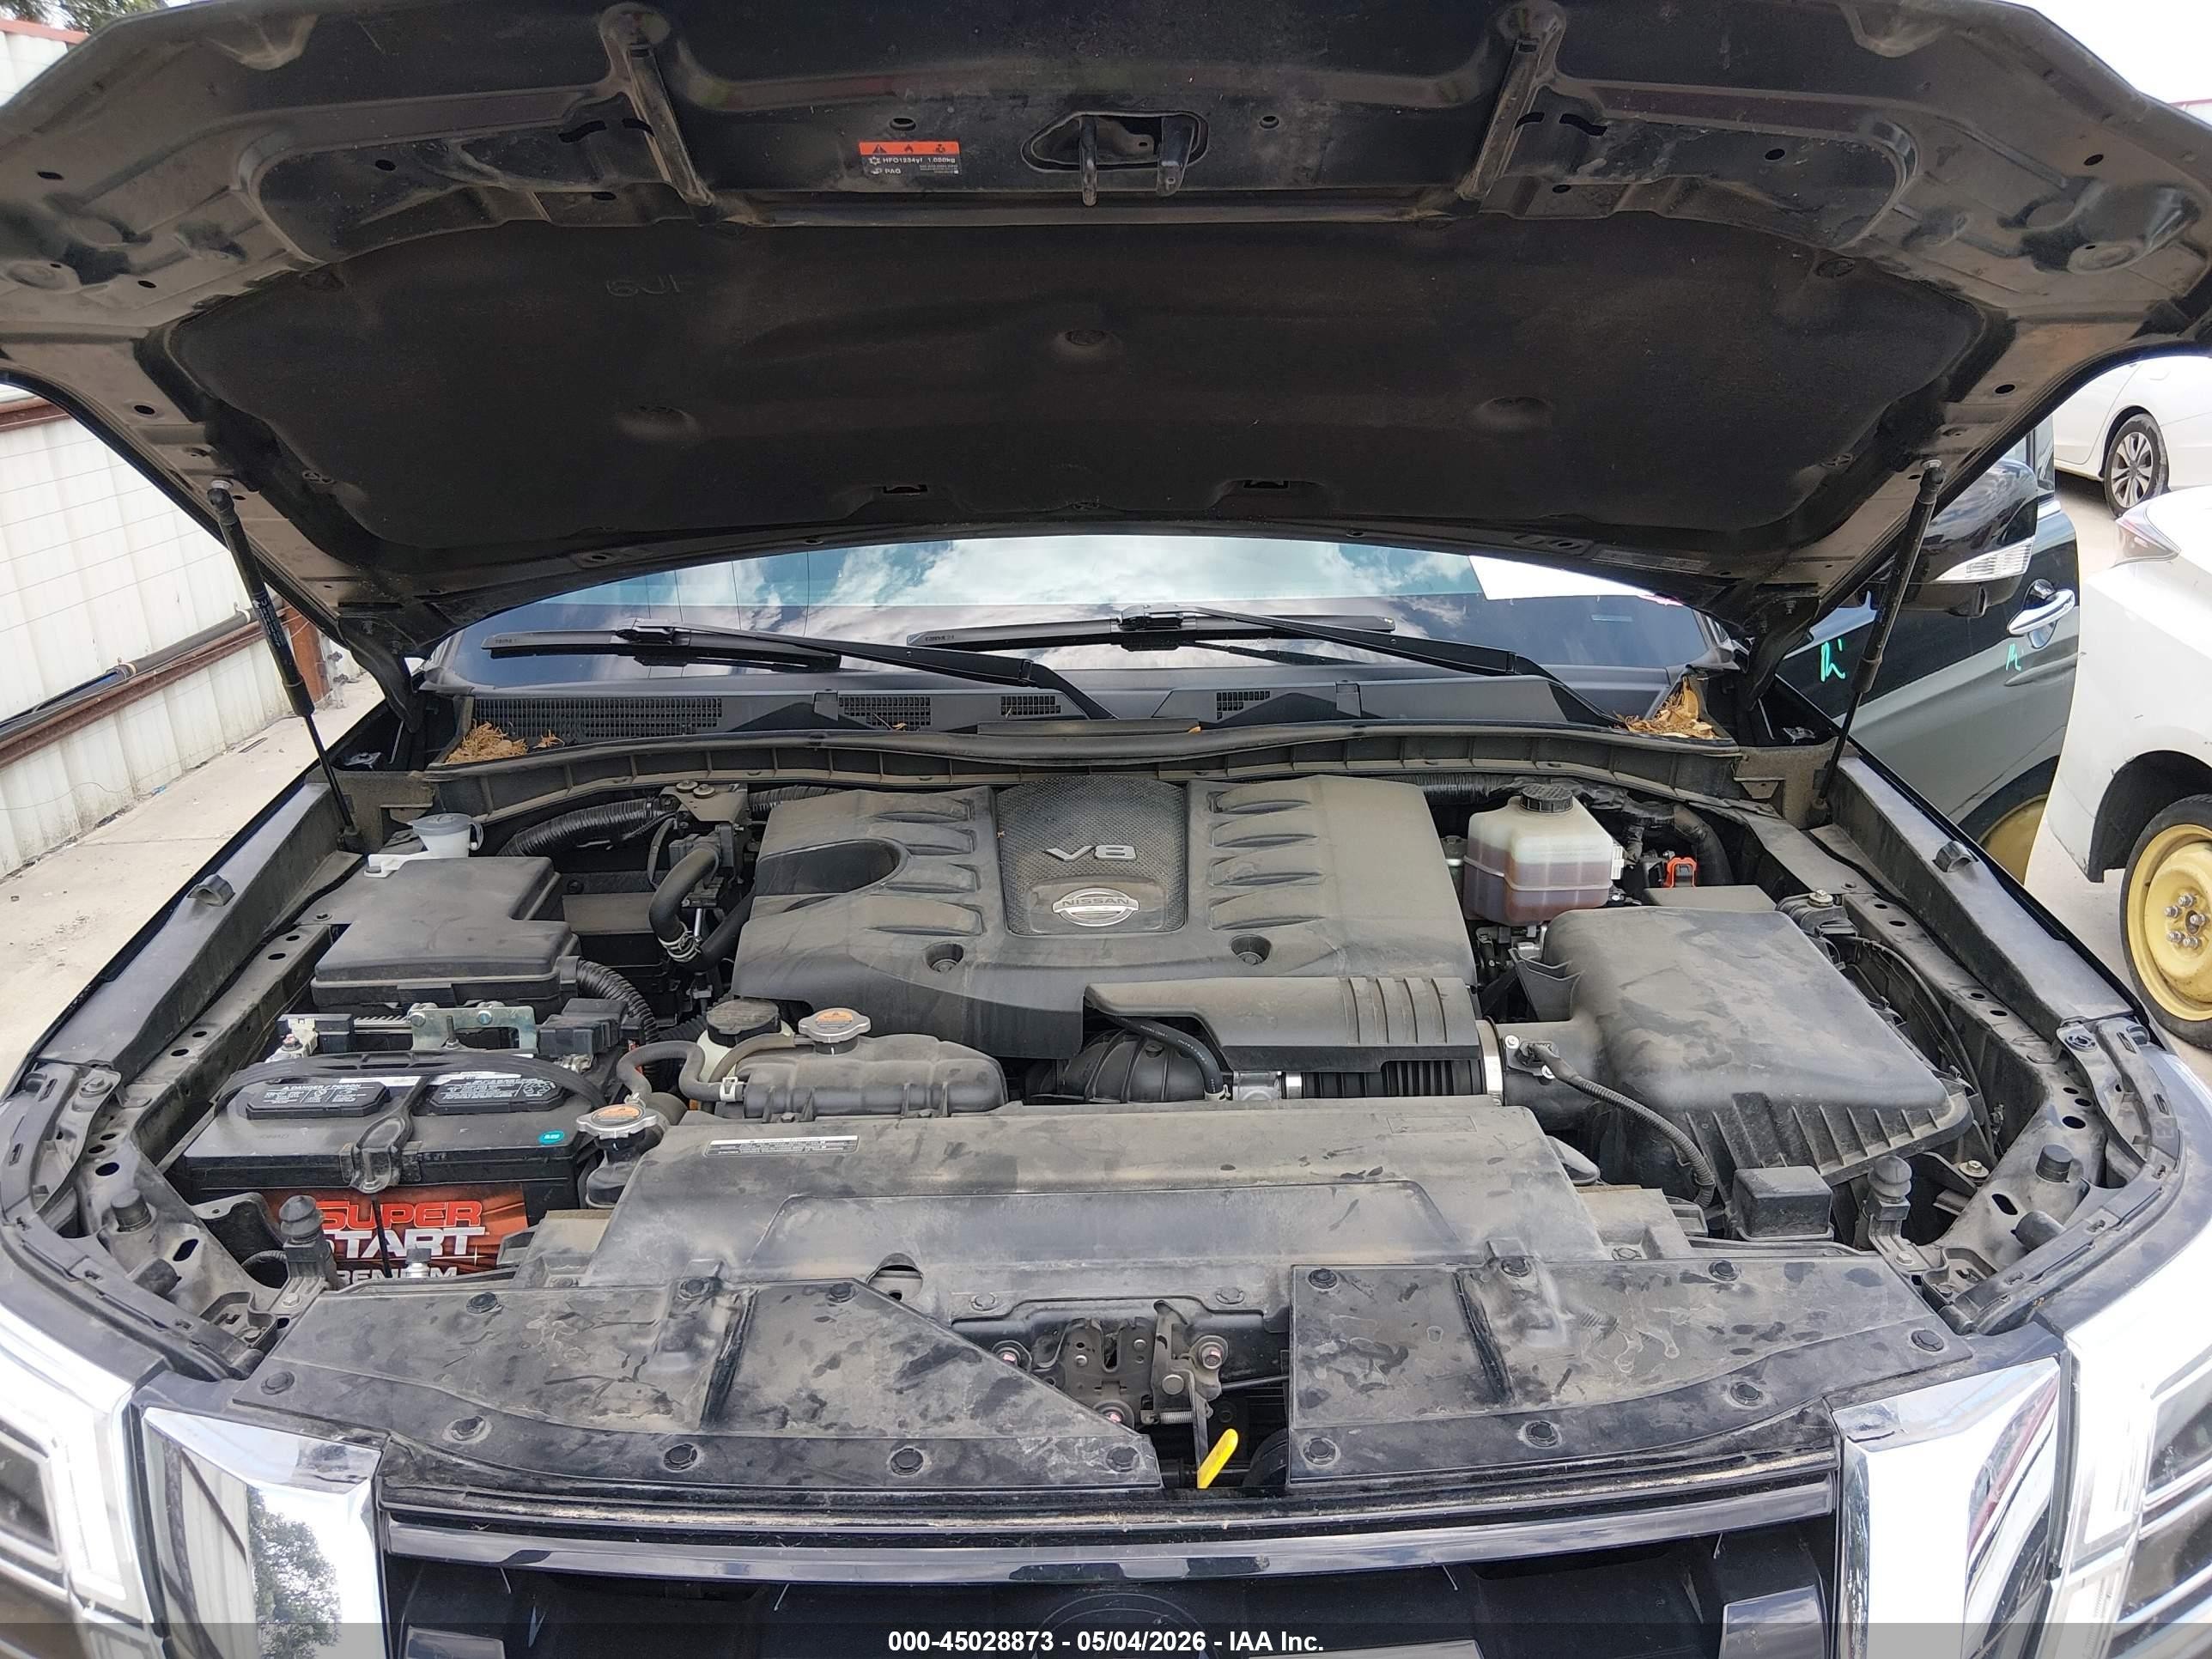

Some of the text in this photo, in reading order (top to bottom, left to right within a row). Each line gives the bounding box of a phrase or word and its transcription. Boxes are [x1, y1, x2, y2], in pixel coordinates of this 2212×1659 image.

[1043, 844, 1138, 861] V8
[1061, 897, 1129, 906] NISSAN
[315, 1200, 483, 1230] SUPER
